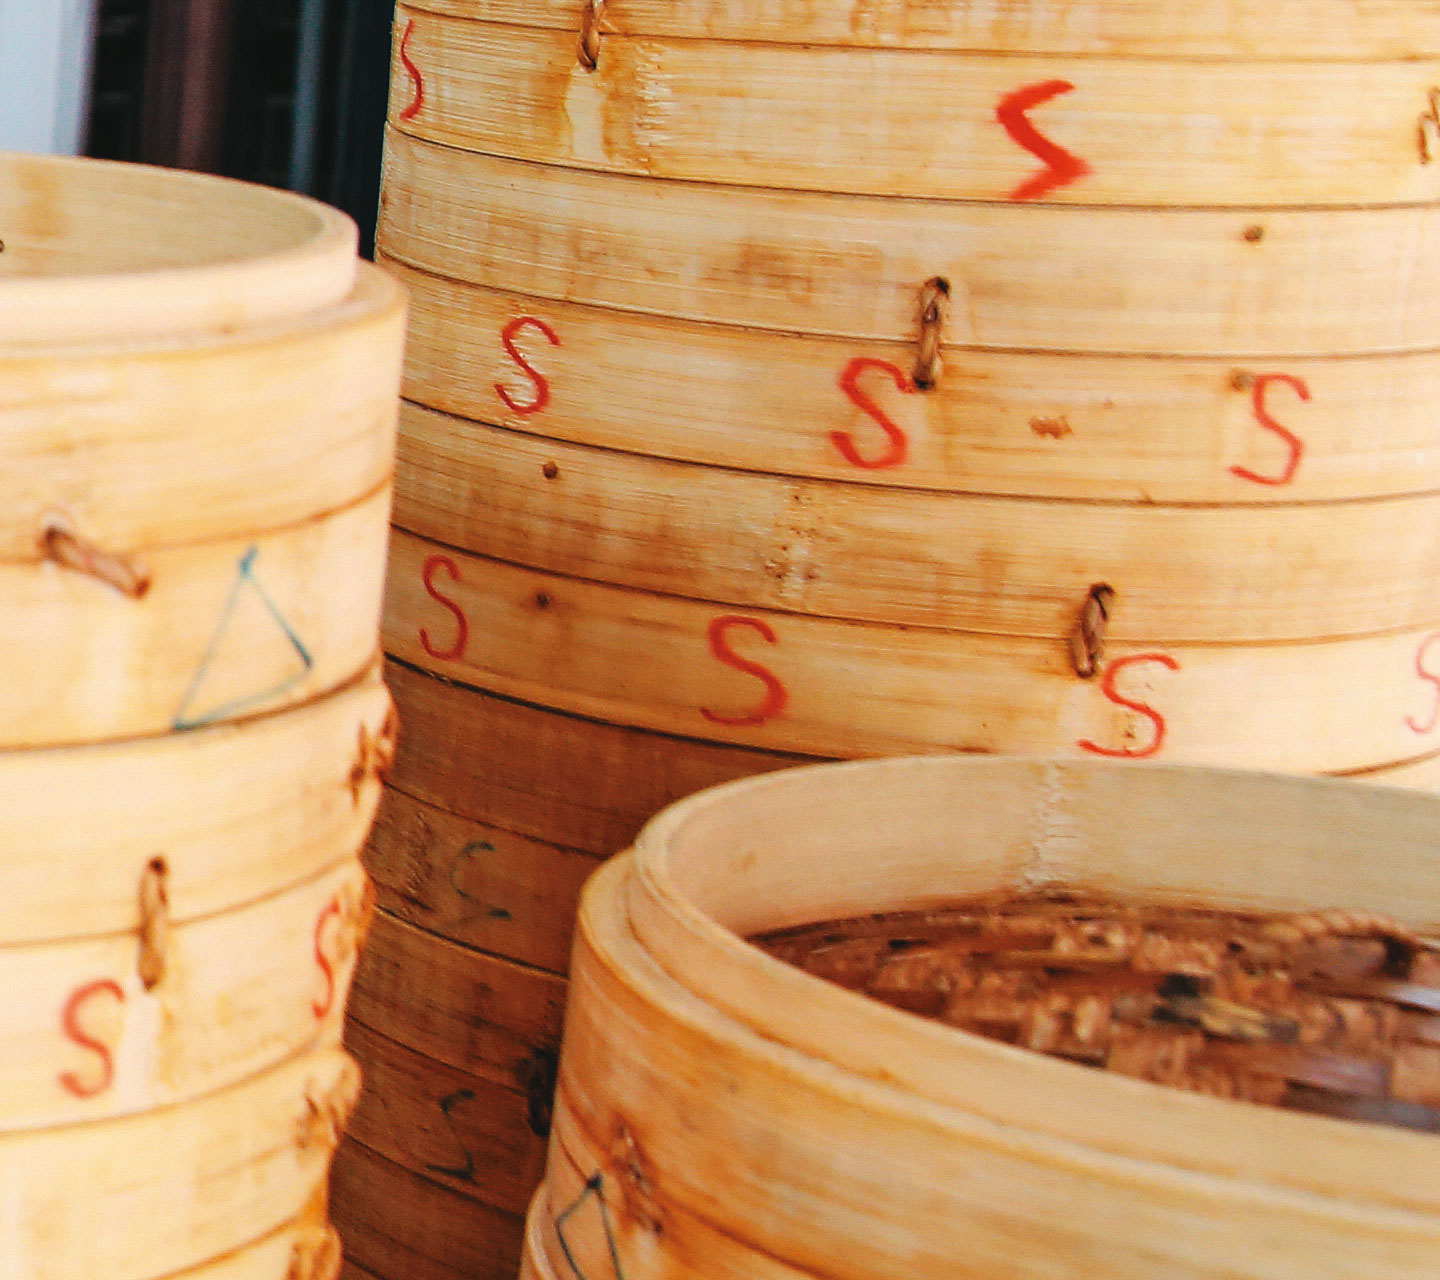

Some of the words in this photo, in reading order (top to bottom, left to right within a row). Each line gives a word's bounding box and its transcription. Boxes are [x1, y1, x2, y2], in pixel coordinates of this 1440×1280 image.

[495, 317, 561, 415] S
[830, 356, 913, 469] S
[1228, 373, 1311, 487] S
[419, 554, 469, 661] S
[700, 615, 787, 727] S
[1079, 652, 1180, 758] S
[58, 980, 123, 1096] S
